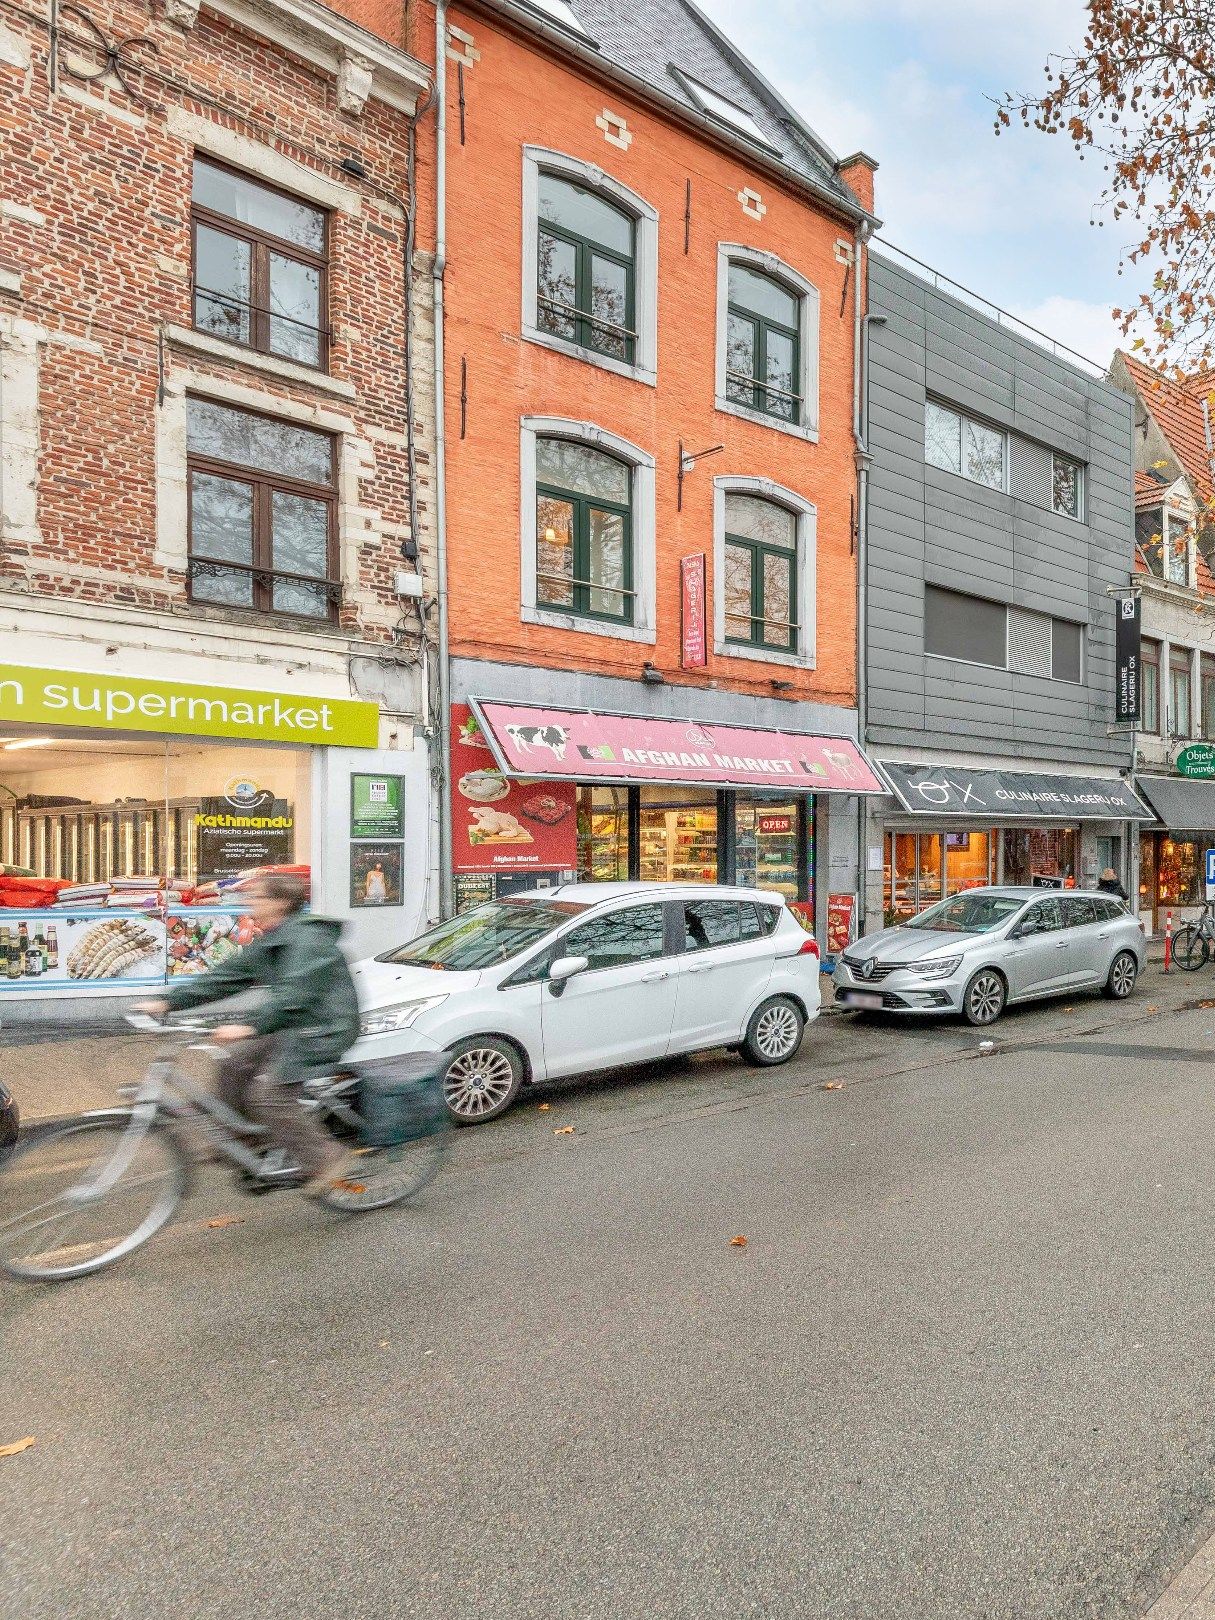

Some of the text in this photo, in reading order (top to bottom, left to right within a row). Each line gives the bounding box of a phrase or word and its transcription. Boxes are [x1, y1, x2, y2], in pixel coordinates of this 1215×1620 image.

[1129, 655, 1135, 668] OX
[42, 682, 333, 731] supermarket
[621, 747, 795, 773] AFGHAN MARKET
[1186, 750, 1214, 761] Objets
[1186, 764, 1215, 774] Trouvés
[995, 789, 1060, 802] CULINAIRE
[1060, 793, 1109, 805] SLAGERIJ
[1111, 796, 1127, 806] OX
[194, 813, 293, 829] Kathmandu
[762, 820, 789, 829] OPEN
[493, 855, 516, 864] Afghan
